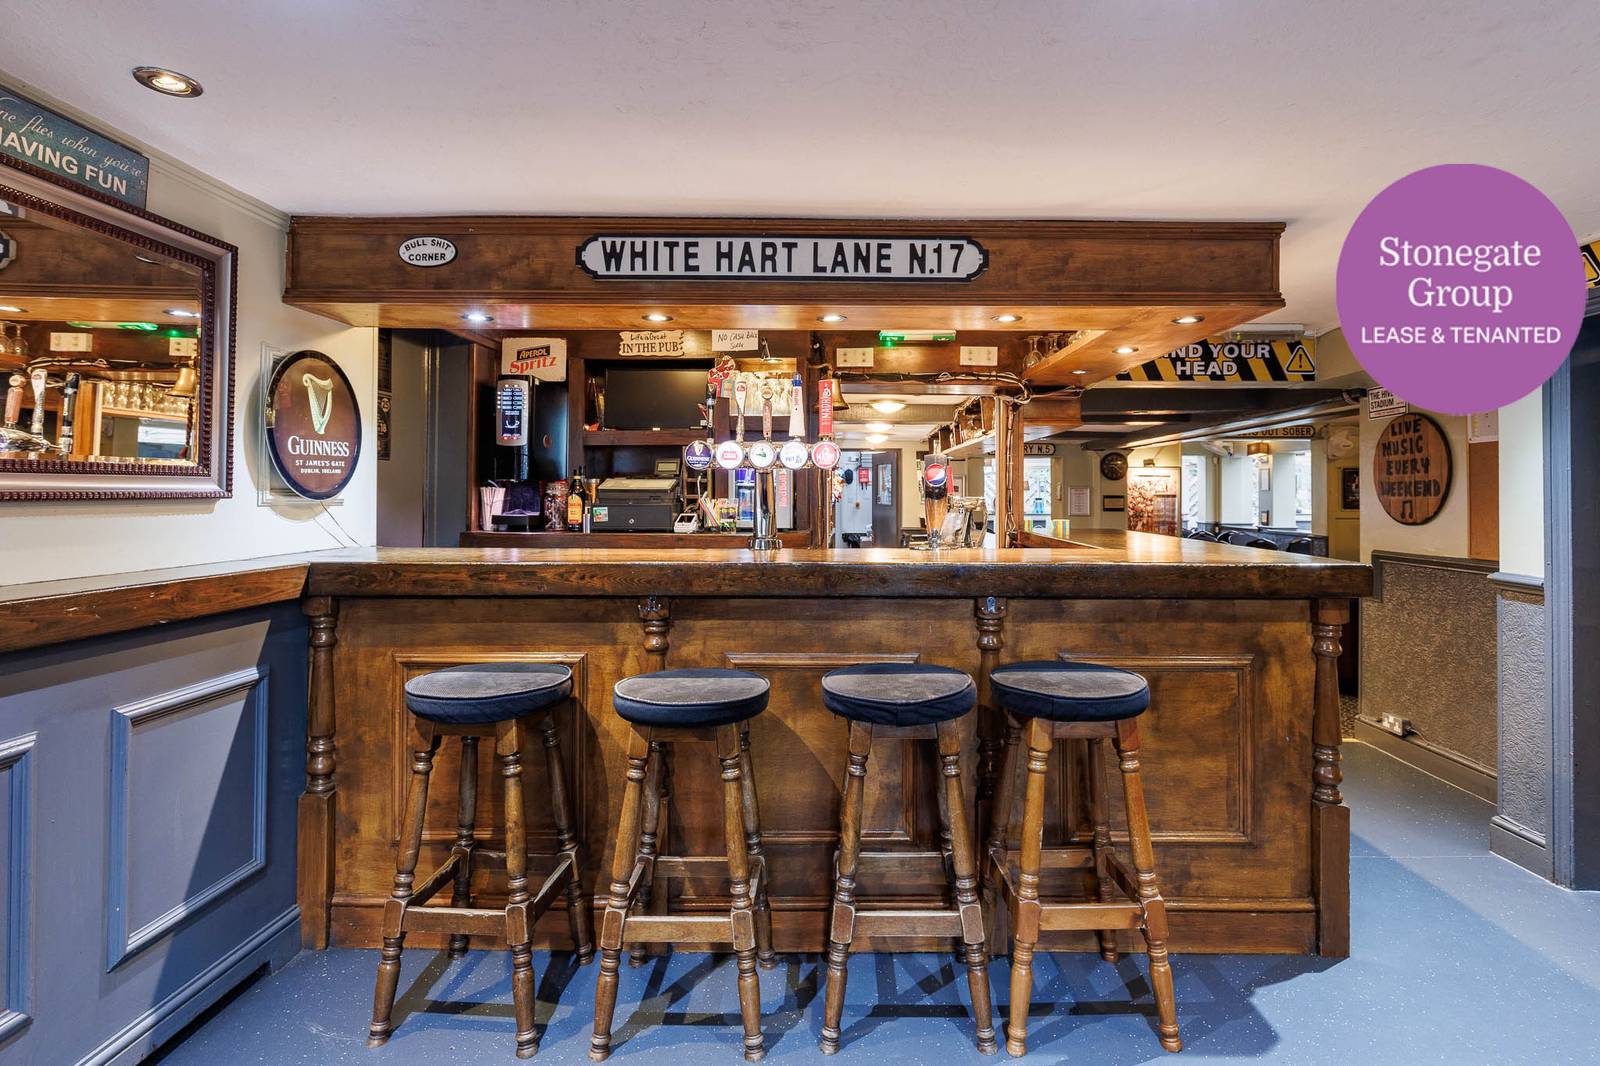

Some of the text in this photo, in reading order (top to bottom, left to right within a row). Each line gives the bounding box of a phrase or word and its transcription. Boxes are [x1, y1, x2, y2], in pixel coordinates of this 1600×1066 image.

[18, 114, 54, 140] flies
[61, 136, 97, 158] when
[85, 164, 127, 196] FUN
[404, 238, 452, 252] BULL SHIT
[408, 252, 446, 262] CORNER
[601, 240, 965, 275] WHITE HART LANE N.17
[717, 332, 728, 343] NO
[519, 348, 548, 360] APEROL
[621, 341, 679, 354] IN THE PUB
[1209, 344, 1271, 359] YOUR
[509, 354, 557, 374] Spritz
[1176, 361, 1238, 376] HEAD
[1370, 391, 1380, 401] THE
[1371, 398, 1395, 410] STADIUM
[1282, 427, 1312, 437] SOBER
[1391, 418, 1422, 437] LIVE
[287, 435, 350, 457] GUINNESS
[1037, 445, 1051, 454] N.5
[1381, 434, 1424, 457] MUSIC
[1385, 457, 1430, 476] EVERY
[1381, 479, 1441, 497] WEEKEND
